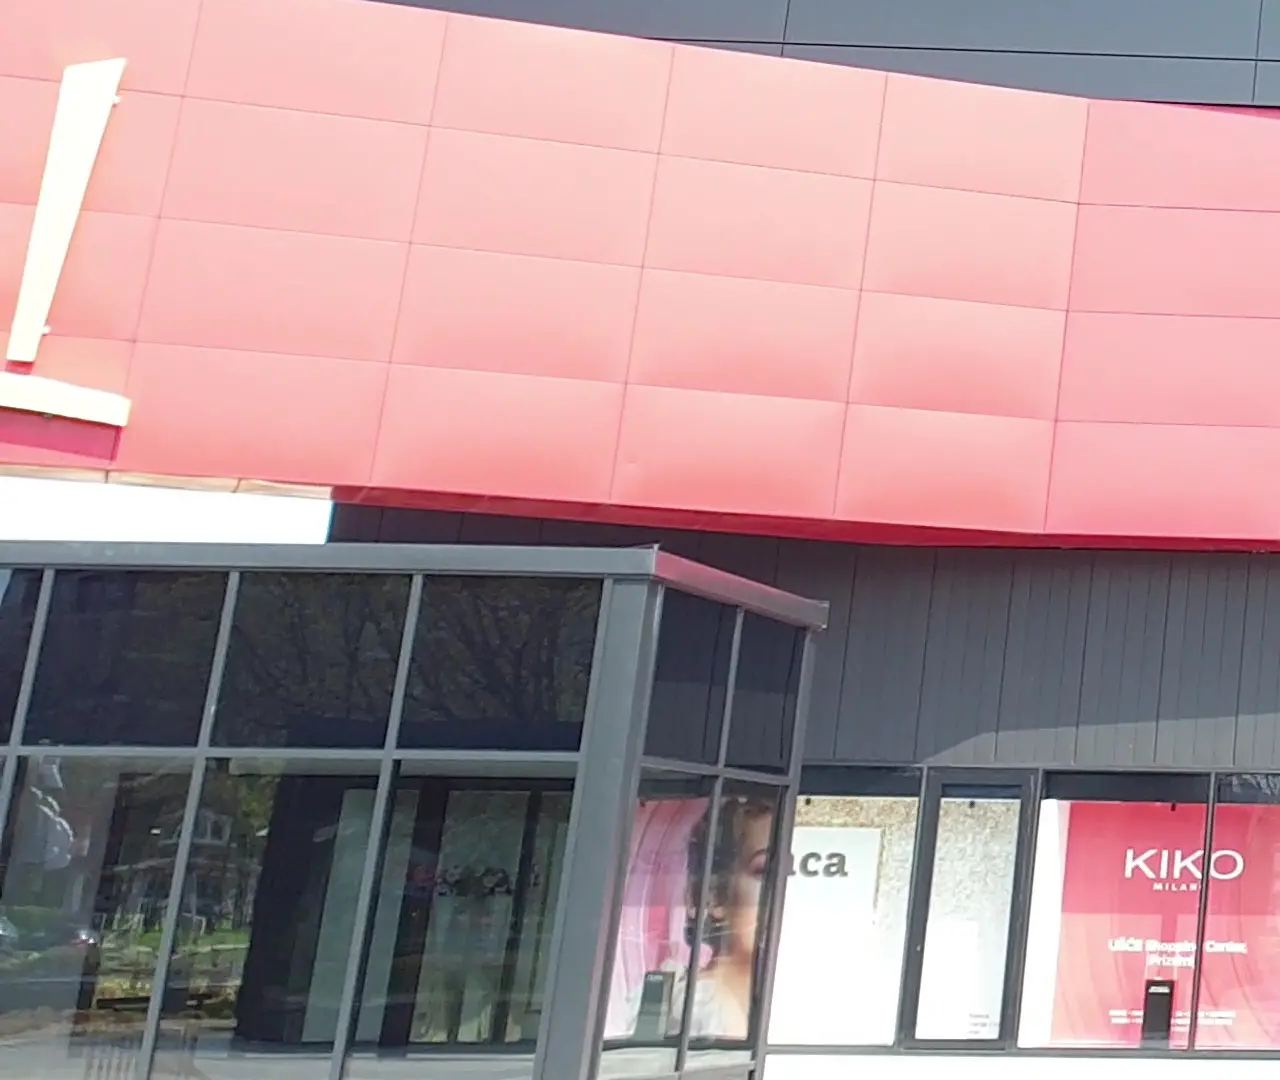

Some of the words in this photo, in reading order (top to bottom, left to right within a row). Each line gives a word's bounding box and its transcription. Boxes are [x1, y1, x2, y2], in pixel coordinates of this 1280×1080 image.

[789, 851, 849, 877] ca
[1124, 848, 1245, 880] KIKO
[1152, 882, 1201, 892] MILAN
